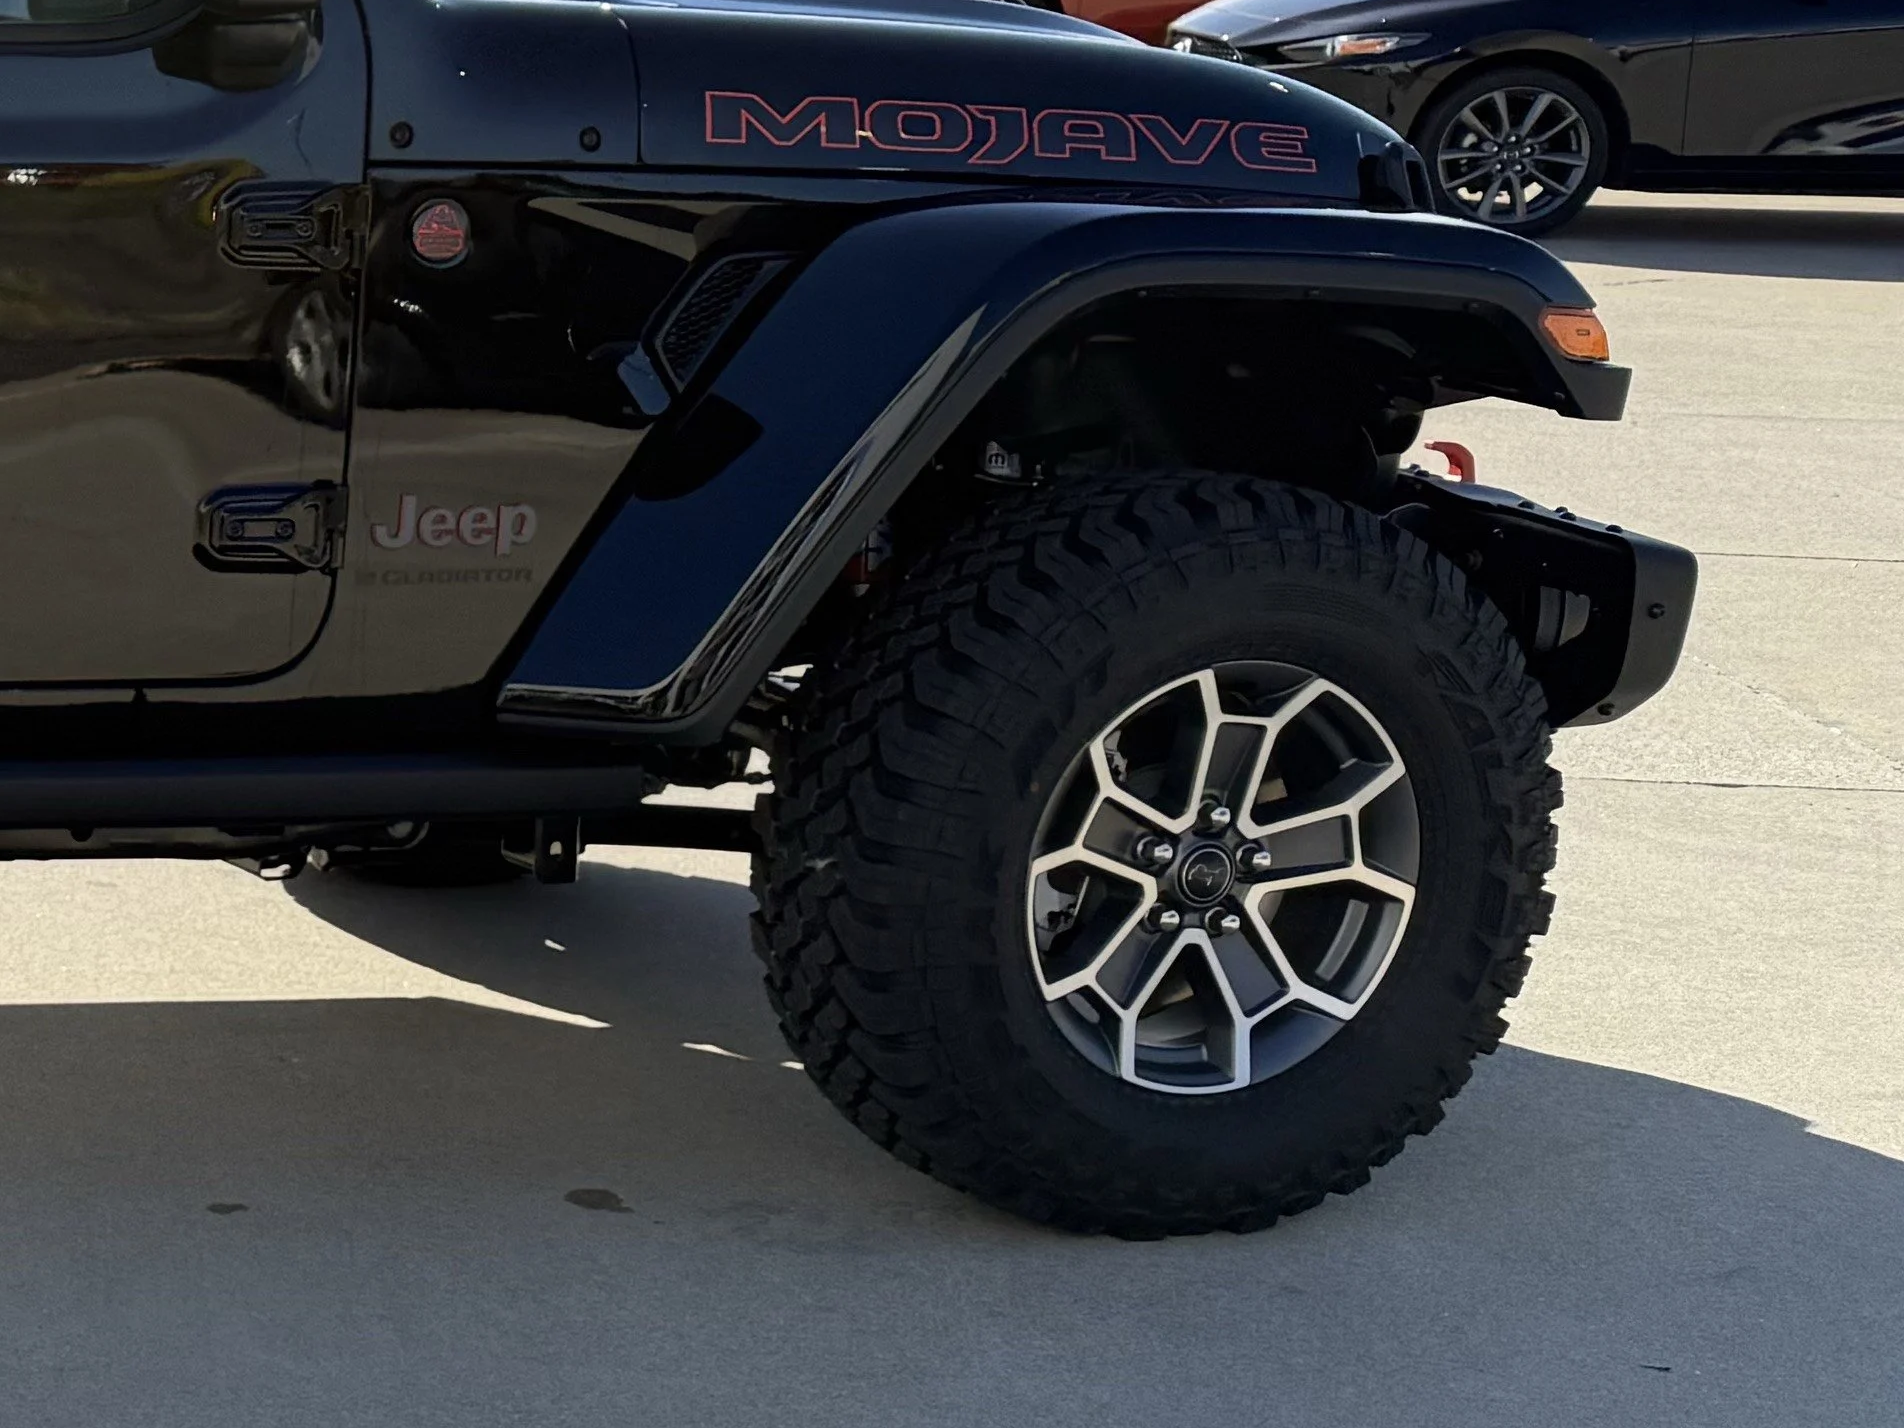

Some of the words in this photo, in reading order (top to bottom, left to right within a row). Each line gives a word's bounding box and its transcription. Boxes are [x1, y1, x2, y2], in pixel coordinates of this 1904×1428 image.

[705, 90, 1318, 173] MOJAVE
[370, 492, 538, 557] Jeep
[381, 568, 533, 586] GLADIATOR
